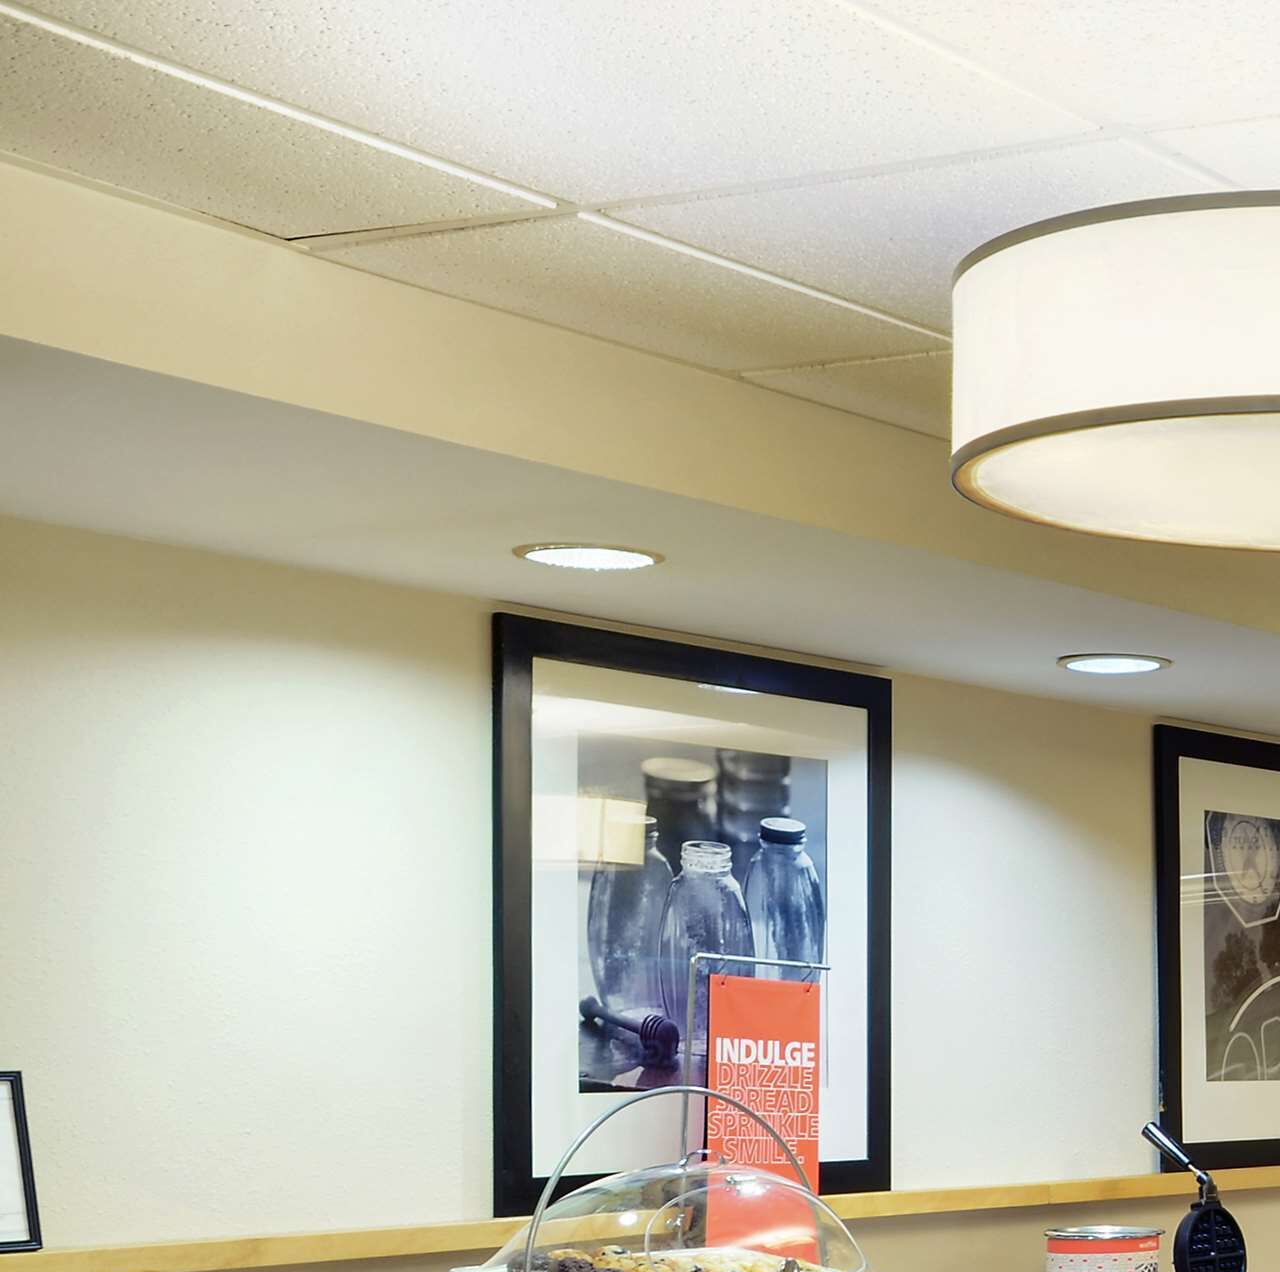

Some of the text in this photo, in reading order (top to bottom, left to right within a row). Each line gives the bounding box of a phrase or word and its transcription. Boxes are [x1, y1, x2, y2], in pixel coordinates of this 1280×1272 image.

[716, 1037, 816, 1067] INDULGE
[717, 1063, 813, 1091] DRIZZLE
[716, 1087, 813, 1115] SPREAD
